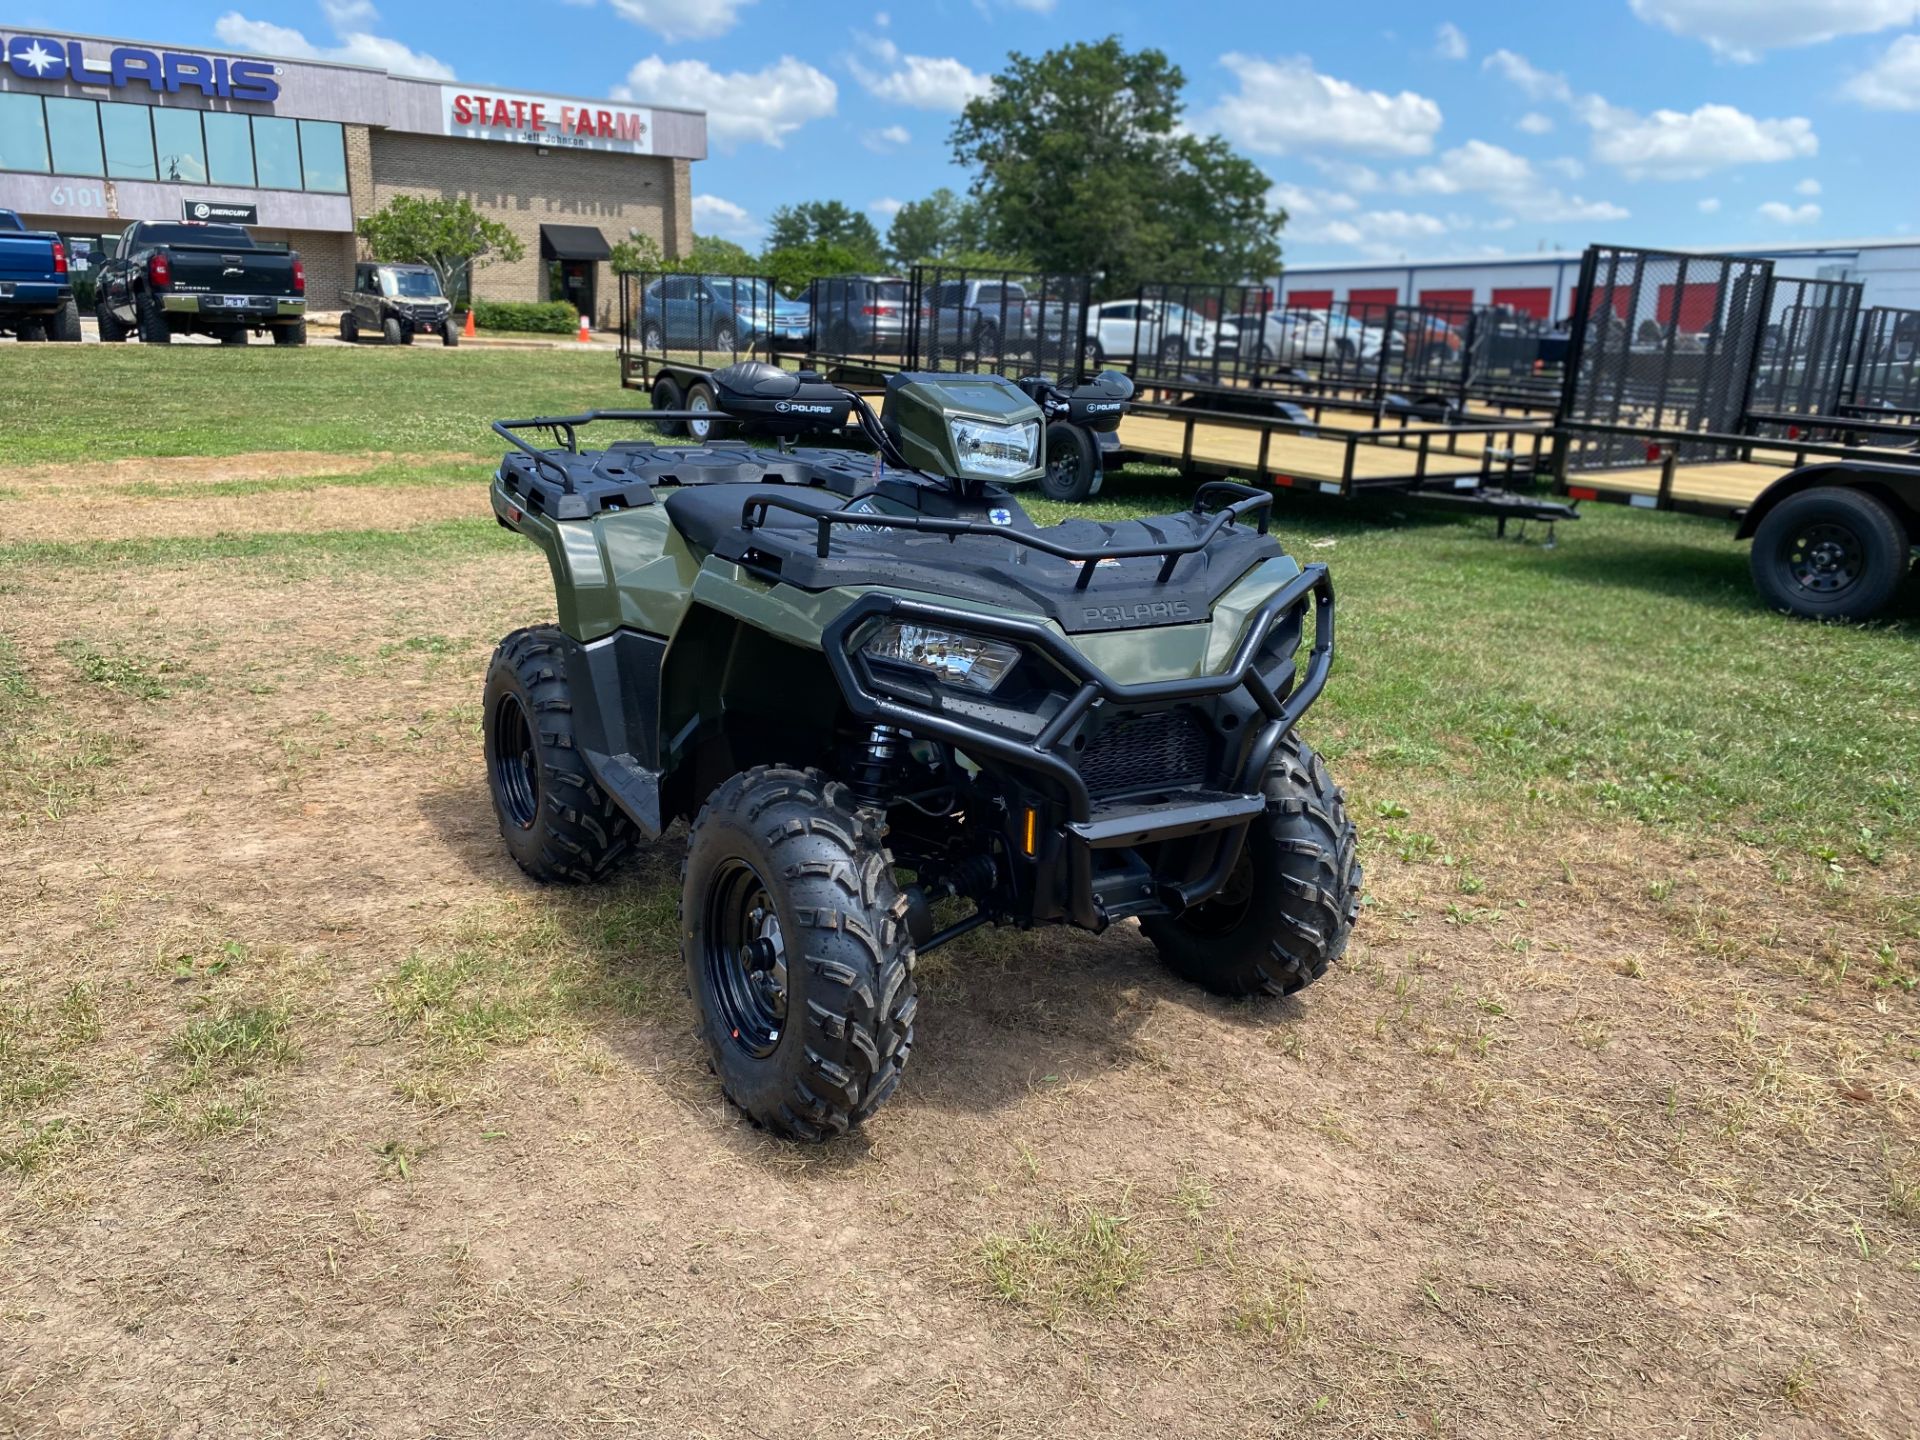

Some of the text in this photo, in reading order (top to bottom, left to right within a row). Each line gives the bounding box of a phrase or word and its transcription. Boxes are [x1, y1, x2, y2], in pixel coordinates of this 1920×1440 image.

[0, 36, 280, 102] OLARIS
[454, 94, 641, 140] STATE FARM
[50, 185, 103, 208] 6101
[210, 208, 251, 217] MERCURY
[791, 404, 833, 414] POLARIS
[1096, 403, 1121, 411] POLARIS
[1081, 600, 1191, 624] POLARIS
